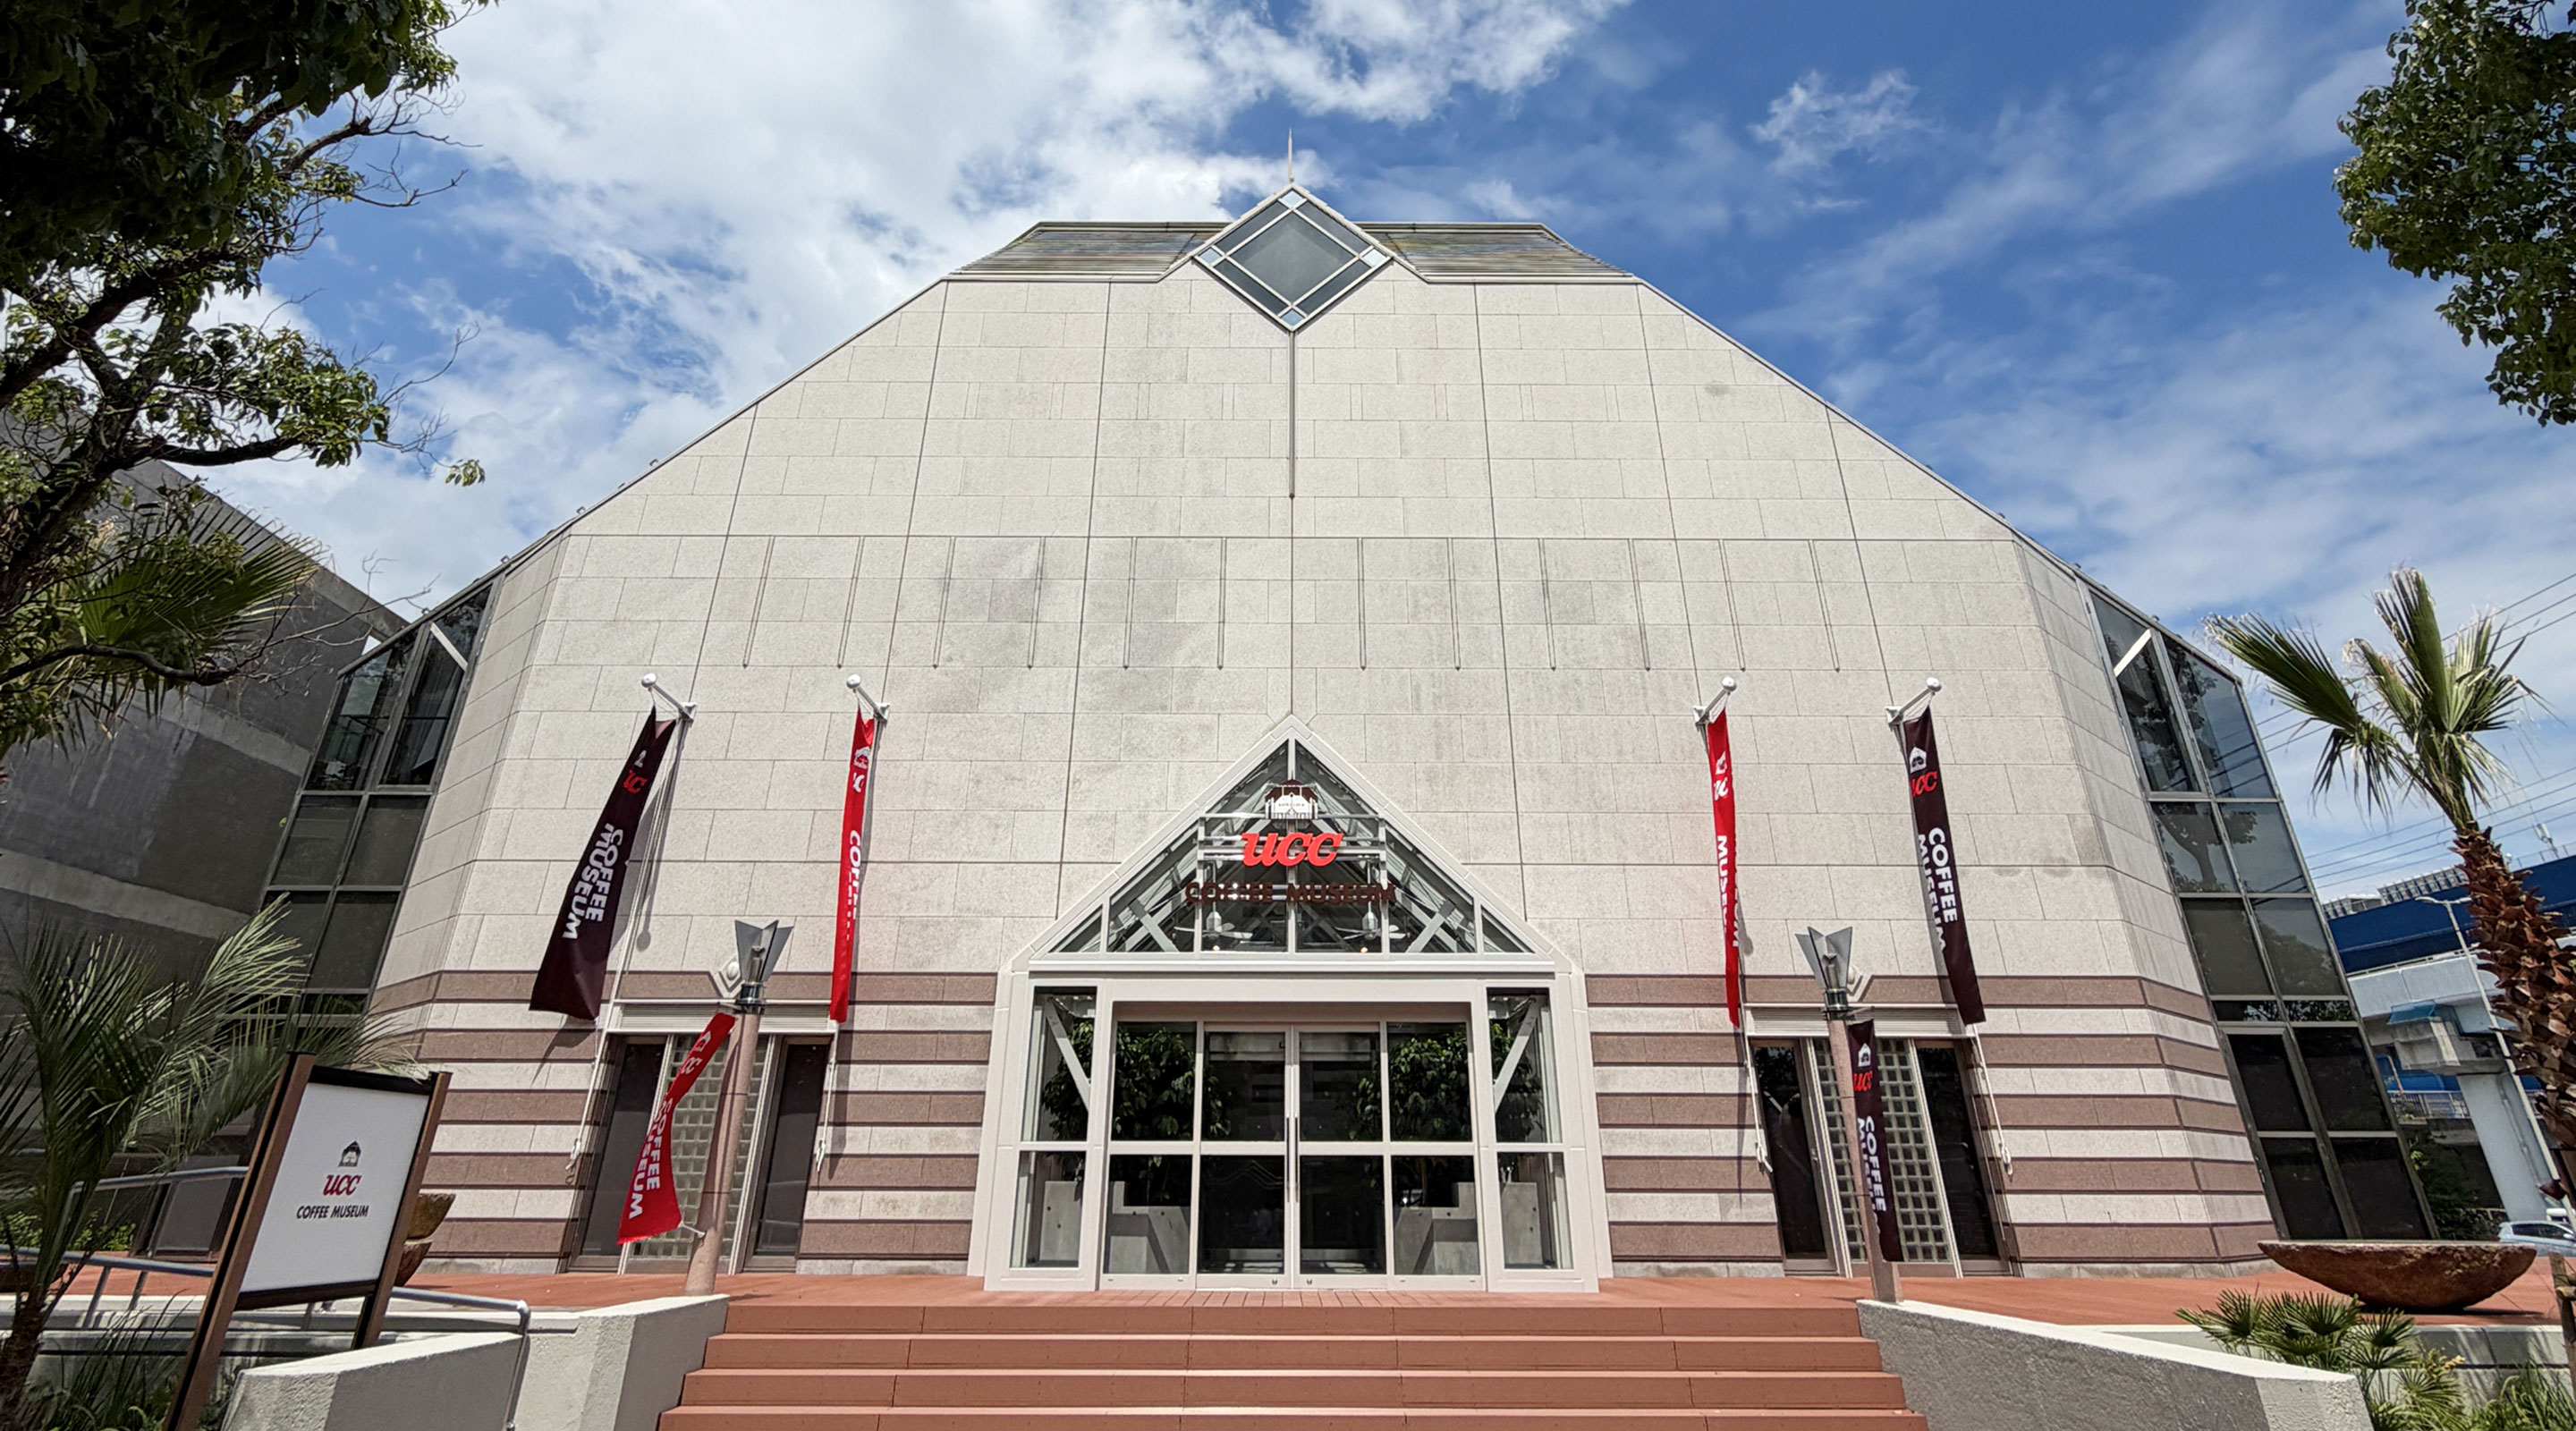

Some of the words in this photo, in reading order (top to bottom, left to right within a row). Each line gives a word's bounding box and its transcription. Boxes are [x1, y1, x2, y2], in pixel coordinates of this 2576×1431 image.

[562, 823, 614, 939] MUSEUM
[585, 829, 623, 922] COFFEE
[1185, 882, 1273, 903] COFFEE
[1287, 882, 1396, 903] MUSEUM
[1928, 827, 1958, 923] COFFEE
[647, 1098, 673, 1190] COFFEE
[1866, 1115, 1886, 1211] COFFEE
[297, 1206, 329, 1219] COFFEE
[331, 1205, 369, 1218] MUSEUM
